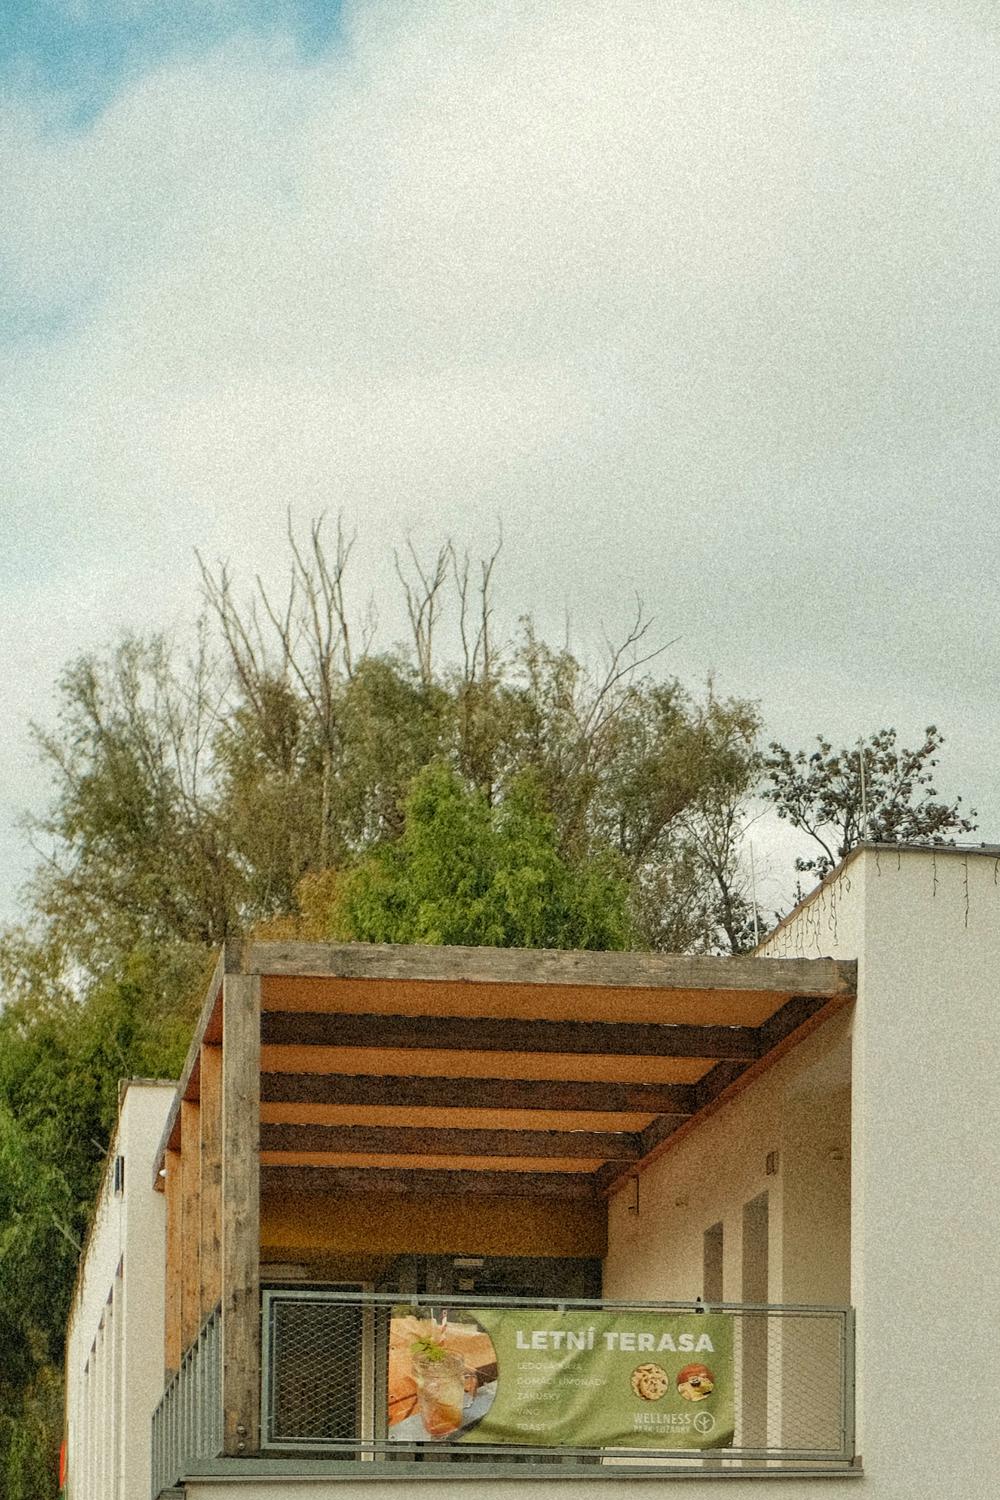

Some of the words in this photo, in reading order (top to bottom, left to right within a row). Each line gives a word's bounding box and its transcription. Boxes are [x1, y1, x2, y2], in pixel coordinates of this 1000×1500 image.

[516, 1326, 595, 1350] LETNÍ
[603, 1332, 715, 1352] TERASA
[633, 1413, 691, 1424] WELLNESS
